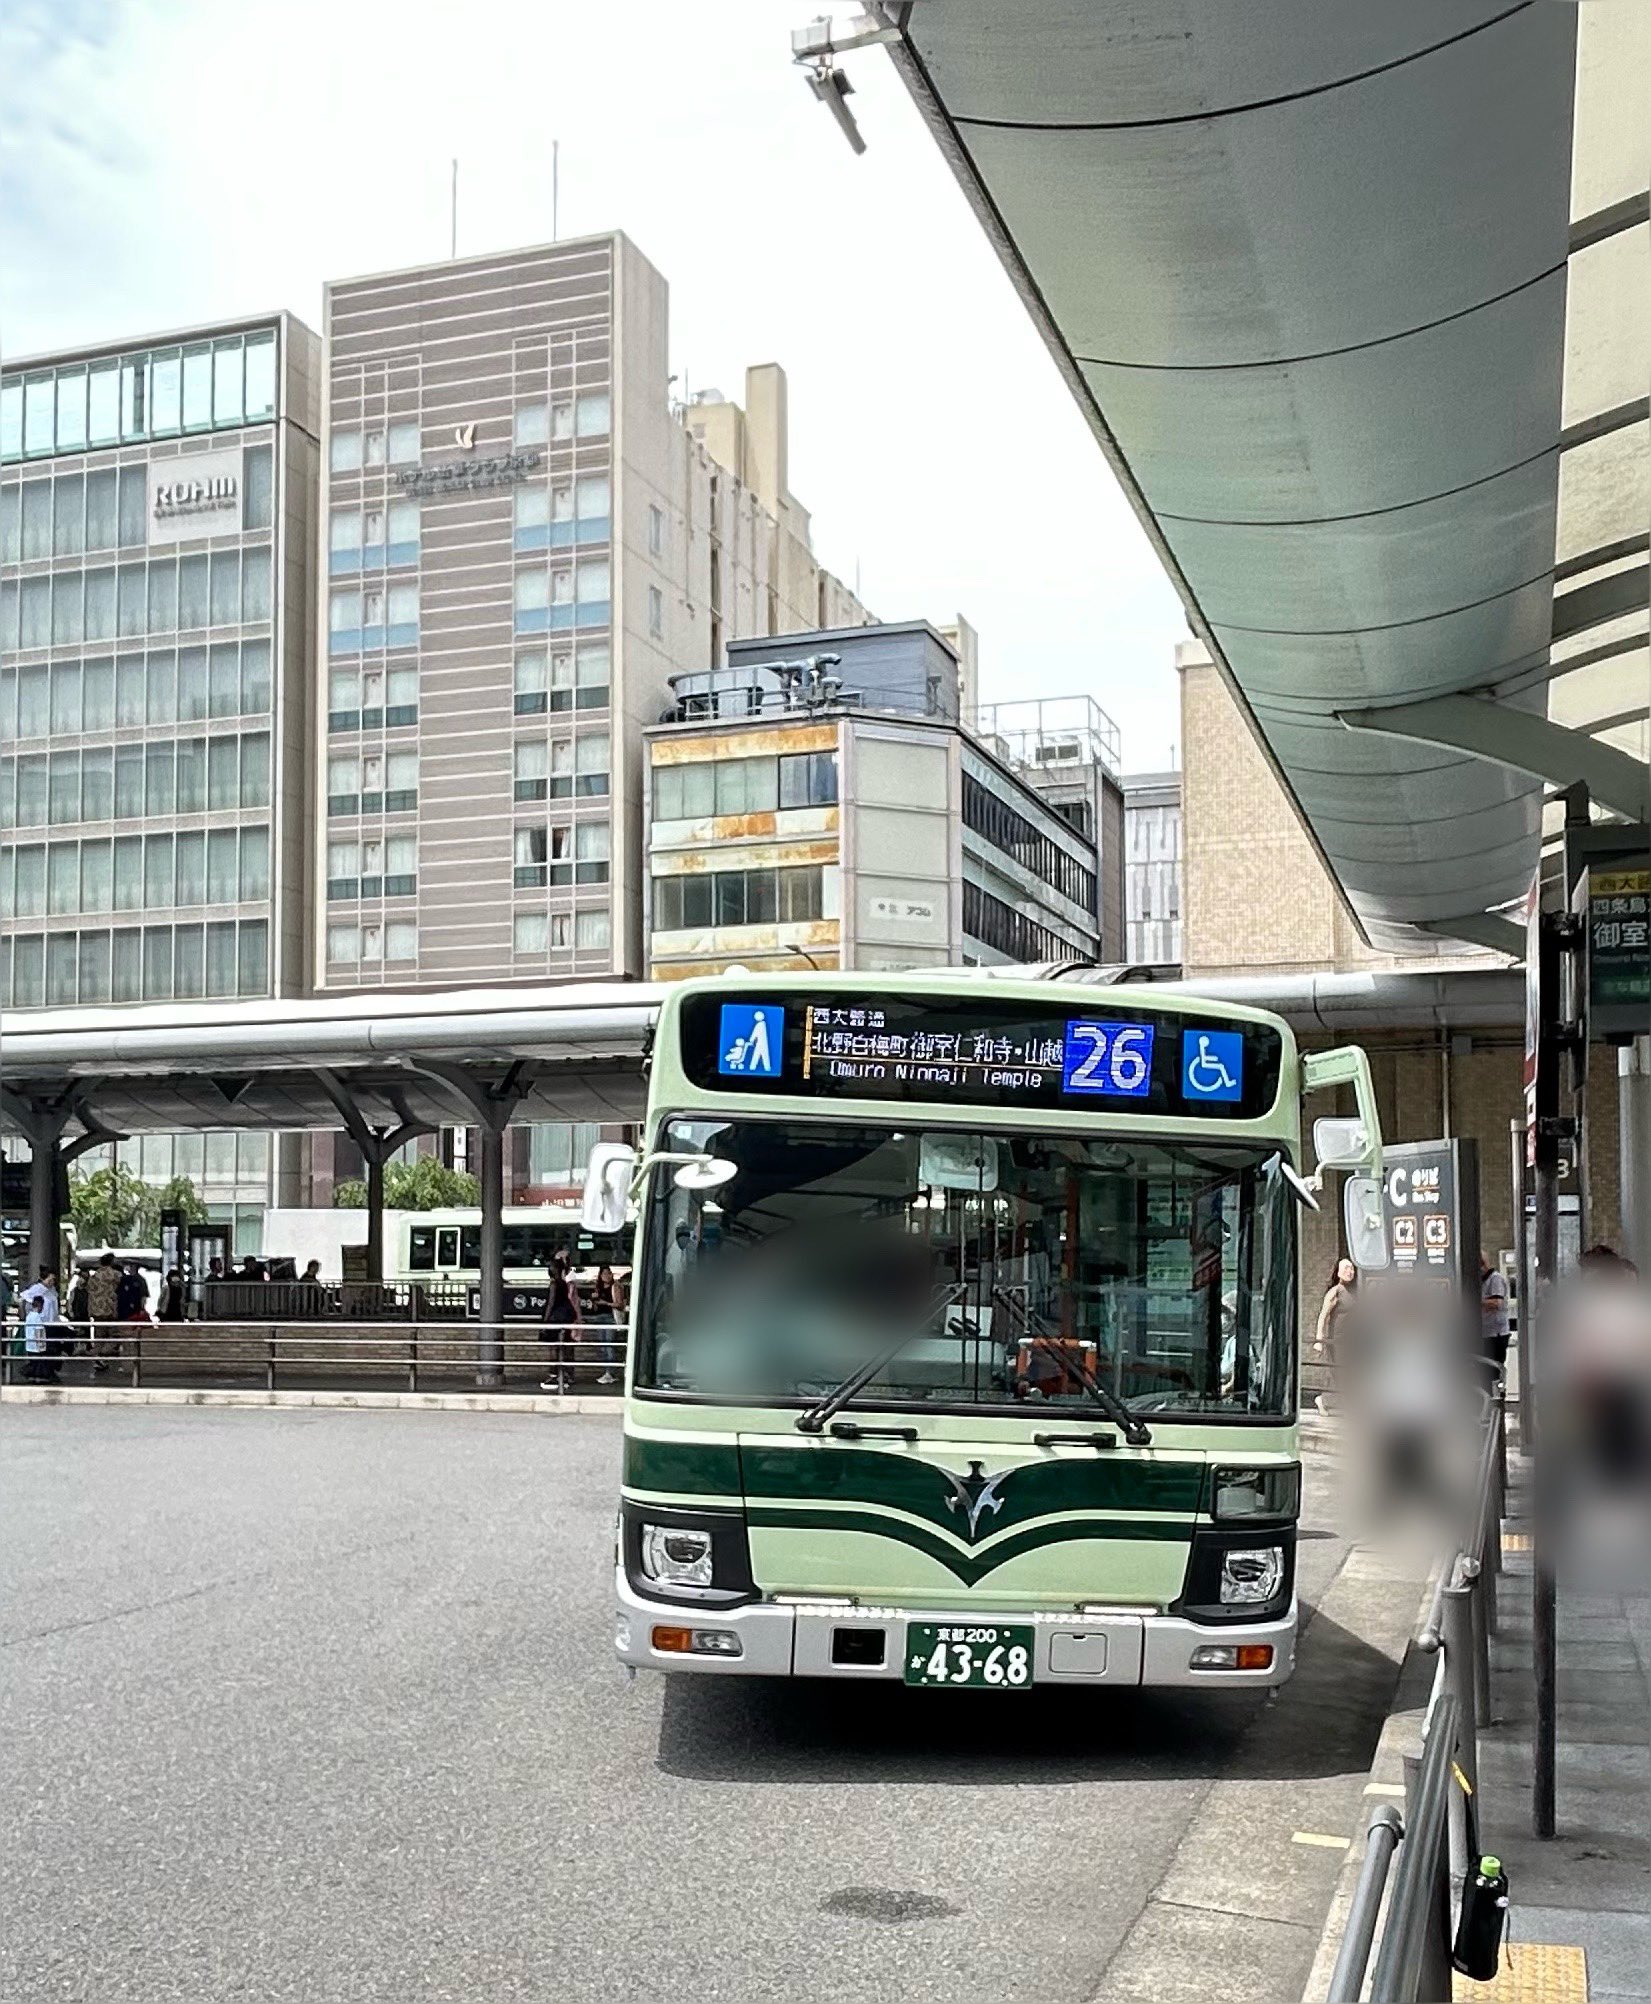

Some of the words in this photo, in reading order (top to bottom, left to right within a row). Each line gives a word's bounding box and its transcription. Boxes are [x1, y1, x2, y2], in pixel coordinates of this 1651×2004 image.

[1070, 1027, 1147, 1090] 26
[983, 1068, 1043, 1088] Temple
[1395, 1219, 1414, 1244] C2
[1426, 1219, 1447, 1244] C3
[926, 1642, 1028, 1685] 43-68
